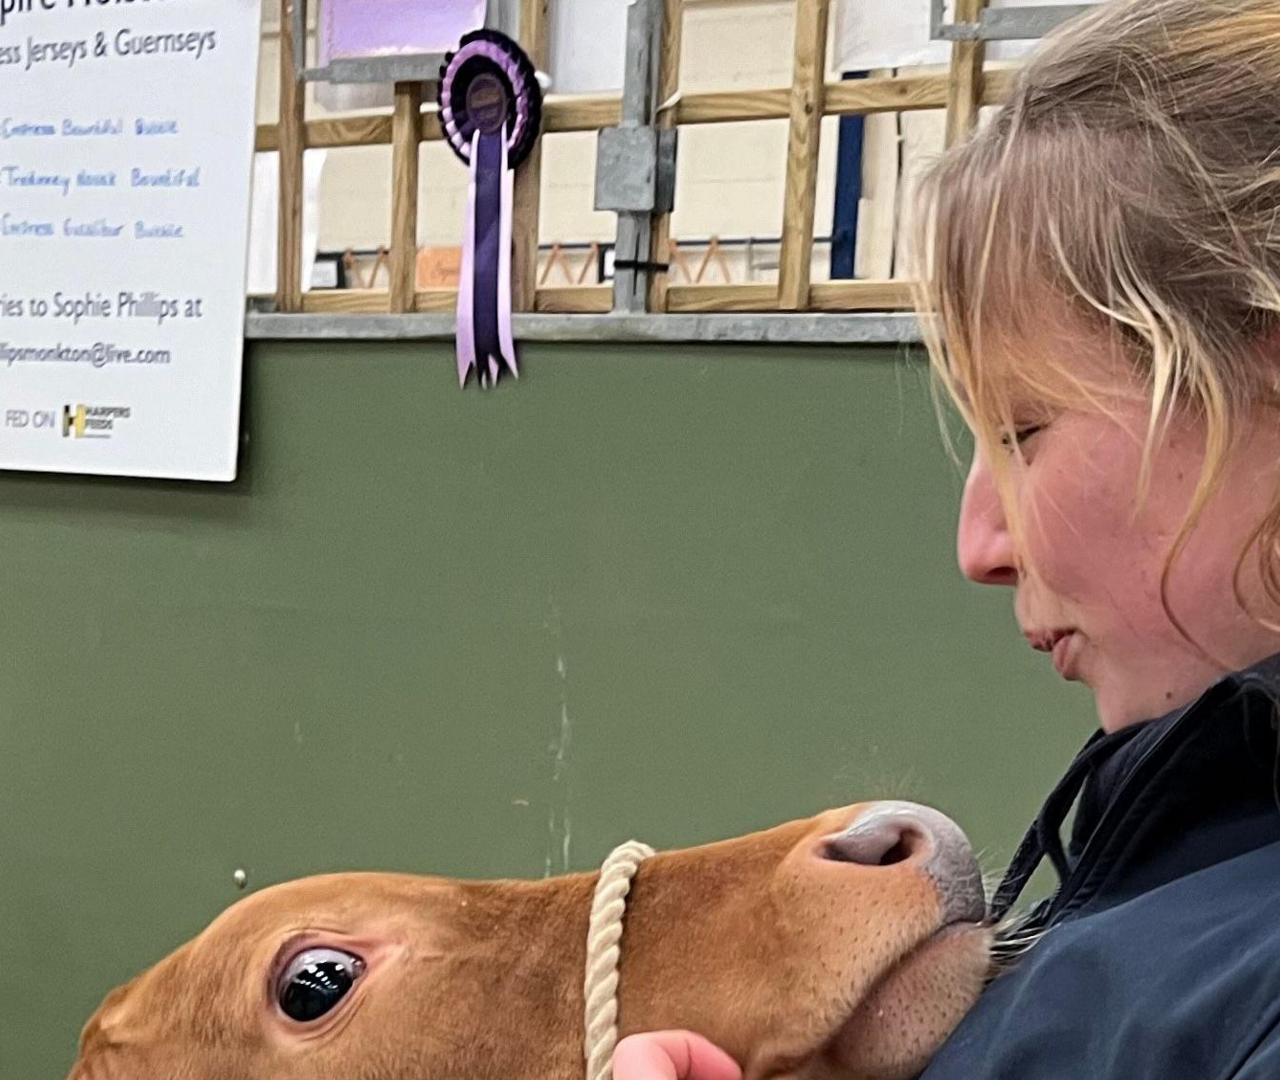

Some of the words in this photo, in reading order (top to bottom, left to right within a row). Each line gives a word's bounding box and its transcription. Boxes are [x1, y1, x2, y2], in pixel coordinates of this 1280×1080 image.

[25, 36, 87, 71] Jerseys
[94, 31, 108, 57] &
[114, 28, 216, 60] Guernseys
[29, 297, 49, 317] to
[53, 292, 111, 325] Sophie
[116, 291, 179, 326] Phillips
[184, 297, 203, 318] at
